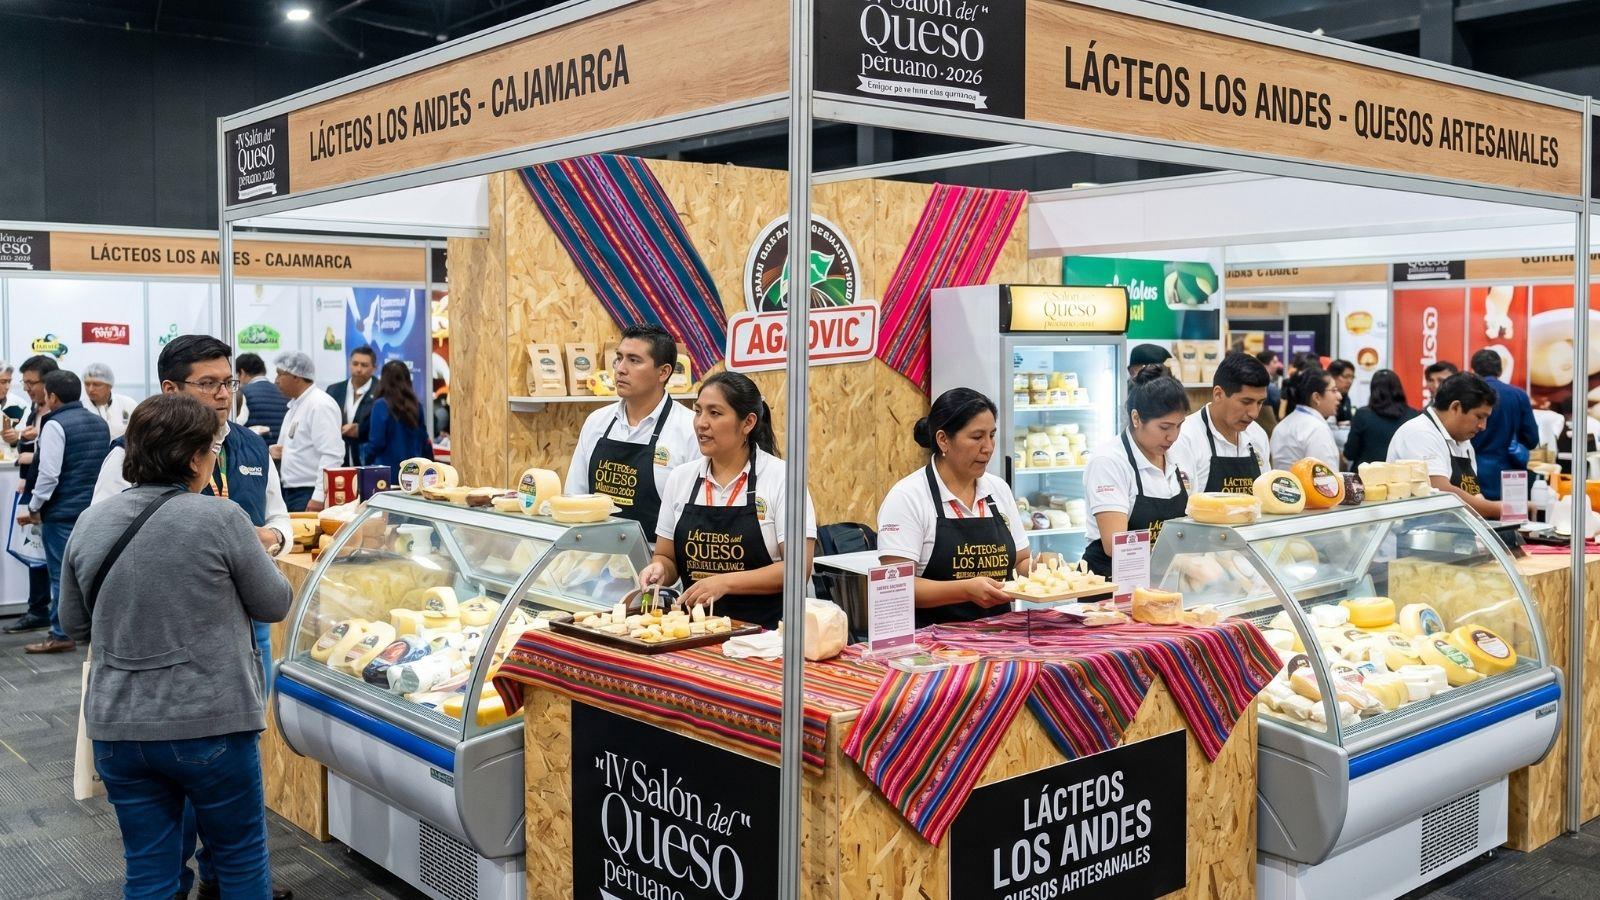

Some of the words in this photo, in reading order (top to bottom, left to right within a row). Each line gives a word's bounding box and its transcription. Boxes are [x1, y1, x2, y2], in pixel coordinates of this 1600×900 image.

[860, 4, 984, 62] Queso
[861, 52, 938, 79] peruano
[945, 66, 983, 85] 2026
[309, 114, 373, 162] LÁCTEOS
[377, 105, 408, 146] LOS
[412, 87, 472, 137] ANDES
[491, 44, 630, 118] CAJAMARCA
[1065, 39, 1191, 108] LÁCTEOS
[1199, 71, 1247, 117] LOS
[1254, 82, 1332, 131] ANDES
[1354, 99, 1434, 148] QUESOS
[1439, 116, 1559, 169] ARTESANALES
[244, 128, 263, 148] Salón
[237, 143, 275, 176] Queso
[0, 242, 31, 255] eso
[90, 242, 161, 263] LÁCTEOS
[166, 249, 195, 264] LOS
[200, 250, 250, 267] ANES
[265, 252, 352, 269] CAJAMARCA
[1043, 300, 1097, 320] Queso
[746, 317, 860, 355] AGOVIC
[685, 541, 745, 562] QUESO
[687, 528, 730, 543] LÁCTEOS
[957, 543, 998, 555] LÁCTEOS
[952, 557, 975, 569] LOS
[977, 554, 1009, 569] ANDES
[631, 760, 703, 826] Salón
[1023, 770, 1125, 832] LÁCTEOS
[601, 792, 744, 900] Queso
[993, 832, 1050, 890] LOS
[1059, 798, 1152, 867] ANDES
[1003, 877, 1058, 900] ESOS
[1061, 845, 1151, 894] ARTESANALES
